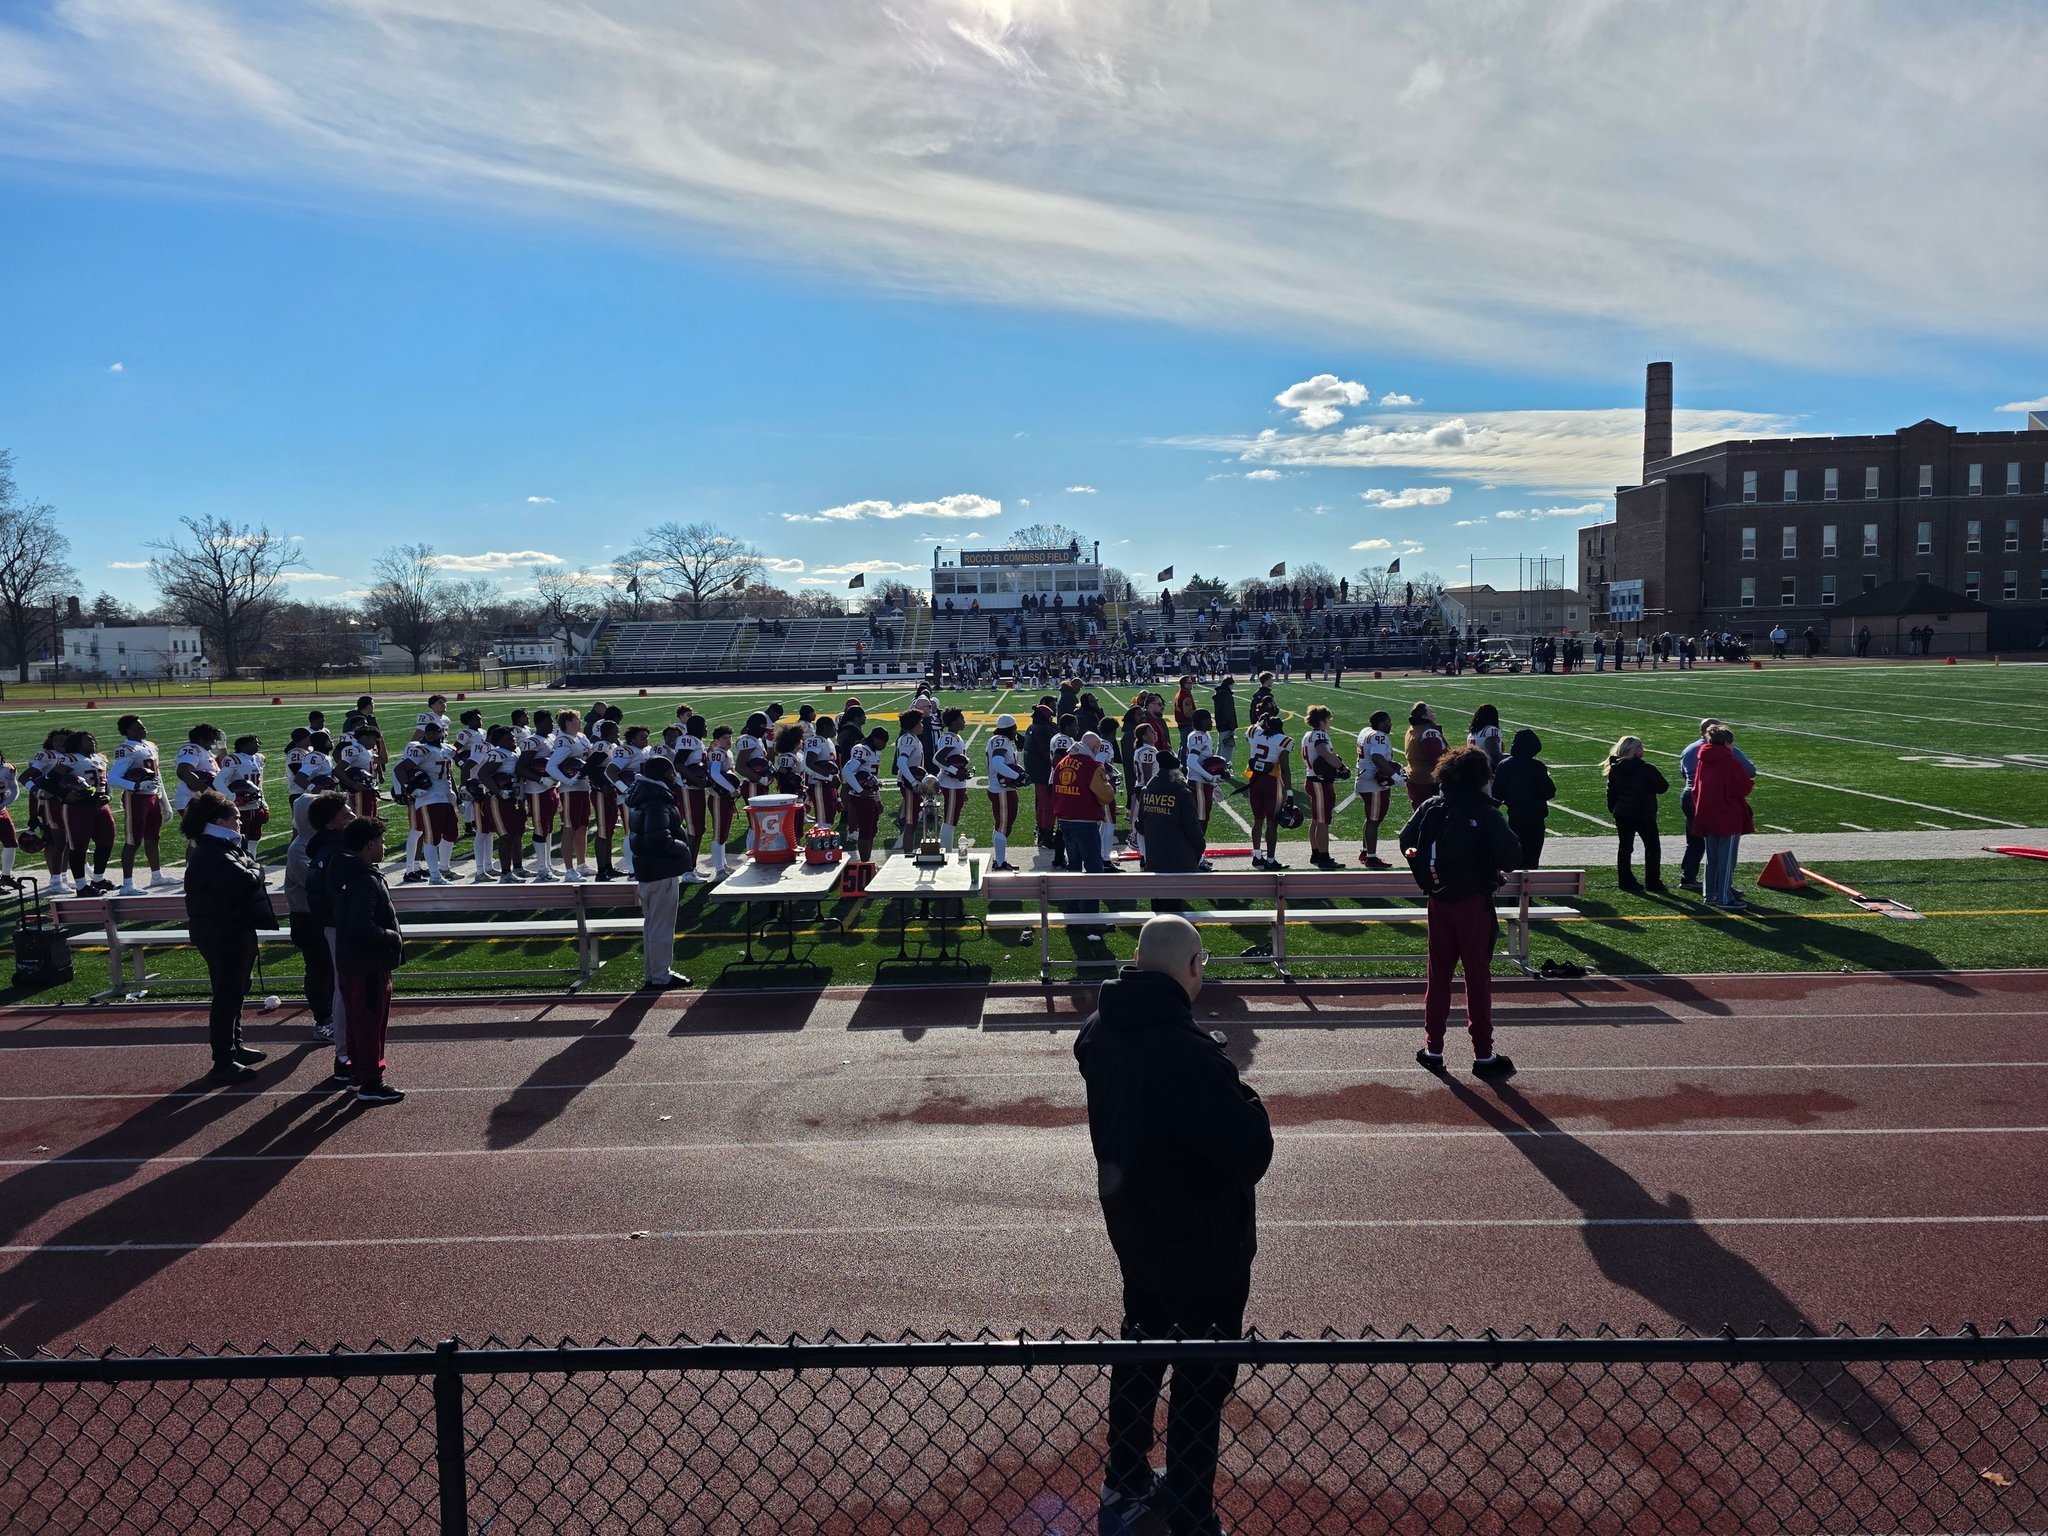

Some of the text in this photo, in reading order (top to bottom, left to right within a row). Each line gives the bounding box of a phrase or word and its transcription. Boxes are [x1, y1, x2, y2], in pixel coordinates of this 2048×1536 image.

[964, 554, 992, 563] ROCCO
[1003, 553, 1046, 562] COMMISSO
[1047, 552, 1069, 561] FIELD
[682, 739, 692, 747] 94
[944, 737, 953, 745] 51
[996, 739, 1004, 747] 57
[1057, 740, 1067, 748] 22
[1195, 736, 1203, 744] 19
[1375, 736, 1385, 744] 92
[615, 749, 624, 757] 55
[853, 750, 863, 758] 23
[1253, 744, 1270, 760] 2
[291, 753, 299, 761] 21
[310, 756, 316, 764] 6
[1144, 754, 1153, 762] 30
[1143, 793, 1176, 807] HAYES
[1144, 805, 1172, 815] FOOTBALL
[762, 815, 780, 835] G
[843, 865, 872, 893] 50
